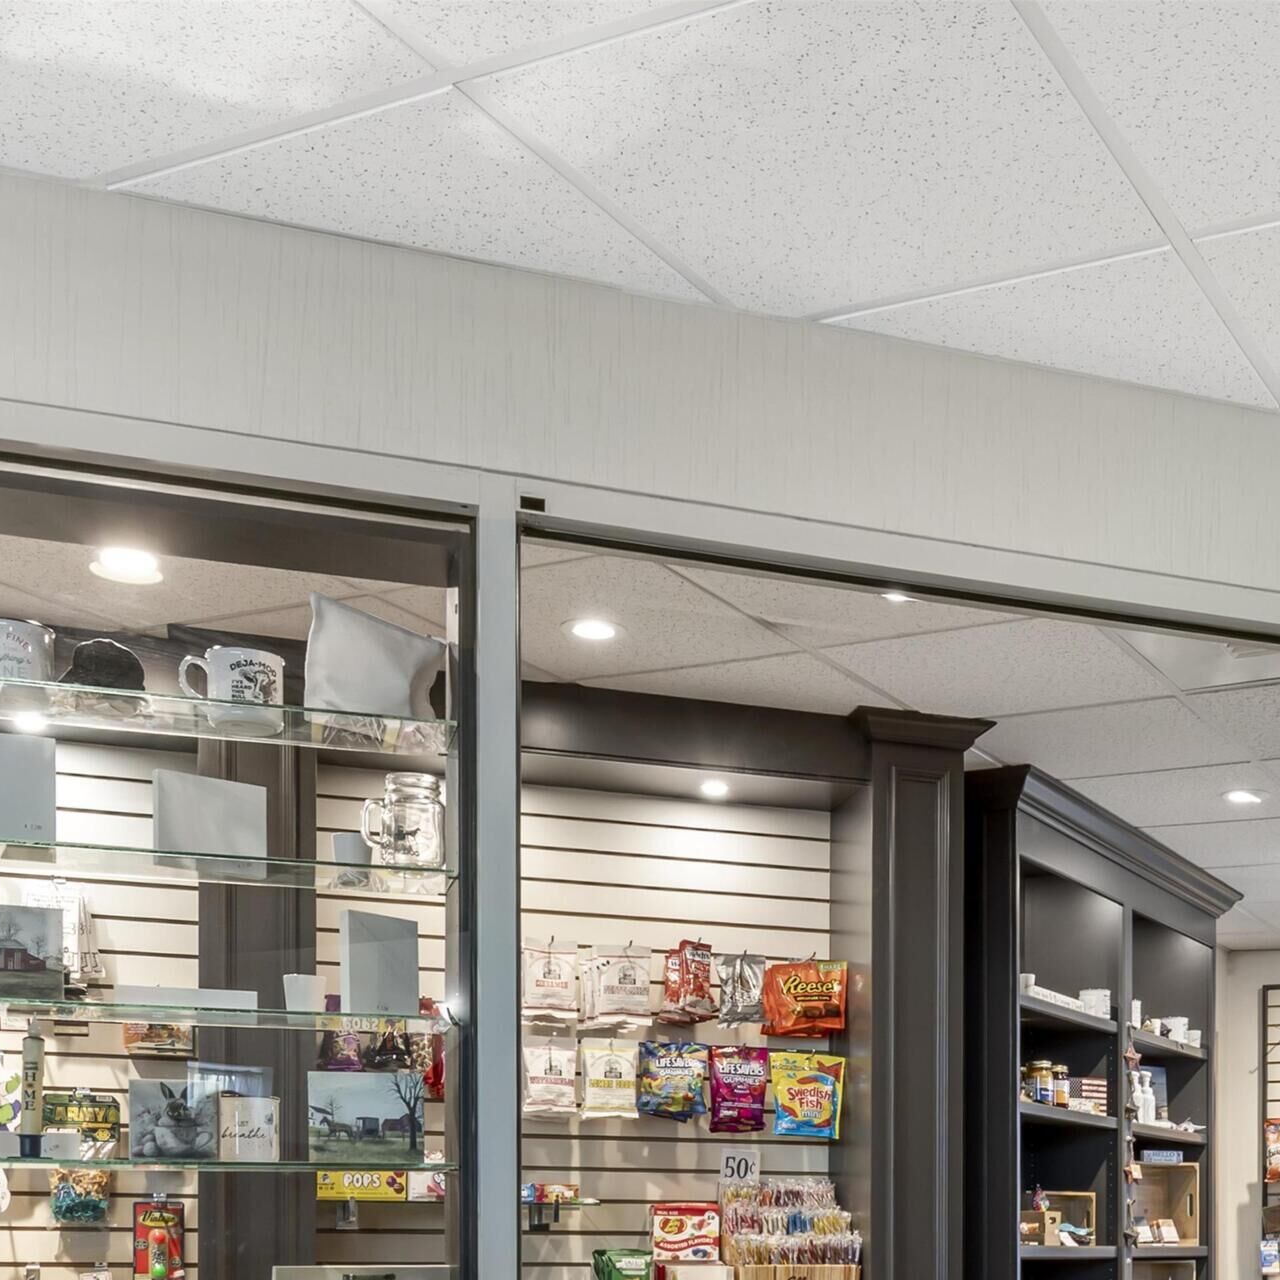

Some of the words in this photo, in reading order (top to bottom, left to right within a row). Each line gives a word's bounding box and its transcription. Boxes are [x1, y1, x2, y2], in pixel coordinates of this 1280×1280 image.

[6, 633, 30, 650] FINE
[783, 975, 841, 996] Reese's
[23, 1071, 37, 1111] HME
[787, 1087, 832, 1101] Swedish
[800, 1098, 823, 1110] Fish
[801, 1109, 821, 1119] mini
[221, 1126, 267, 1141] breathe
[724, 1156, 756, 1180] 50¢
[343, 1173, 382, 1190] POPS
